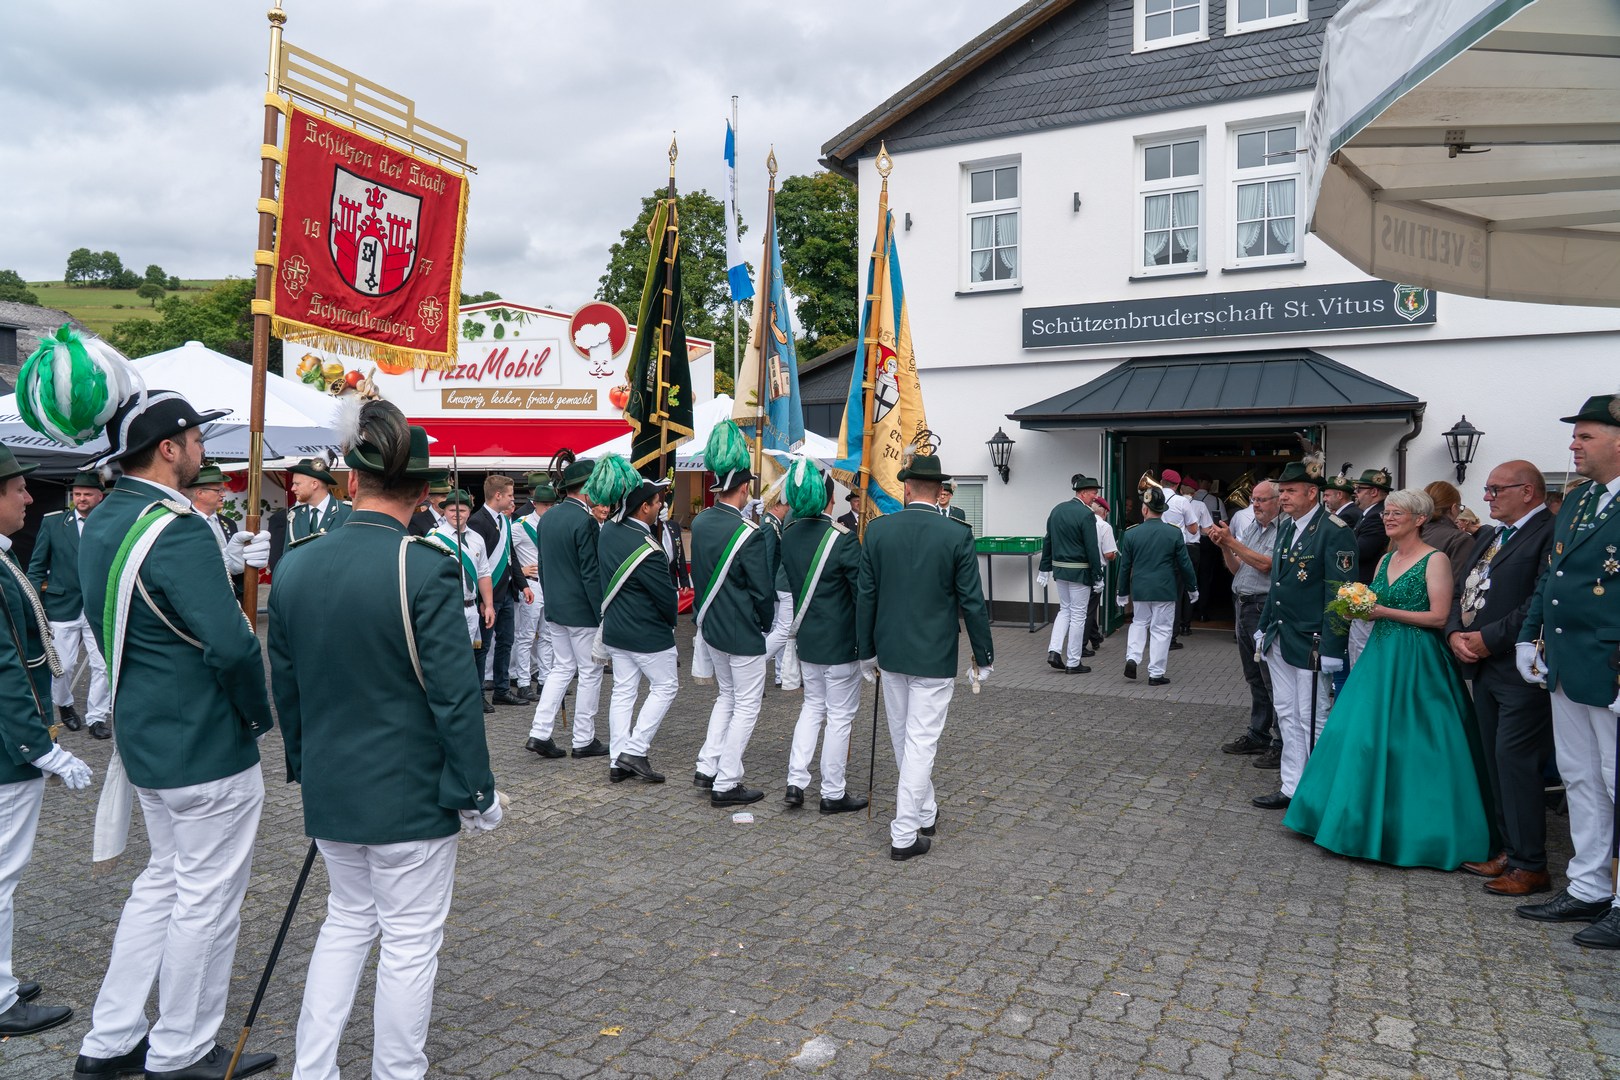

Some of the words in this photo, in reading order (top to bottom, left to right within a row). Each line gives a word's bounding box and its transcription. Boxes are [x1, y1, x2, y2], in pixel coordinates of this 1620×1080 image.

[304, 119, 372, 168] Schützen
[380, 155, 403, 179] der
[408, 163, 446, 195] Stadt
[419, 258, 434, 275] 77
[307, 292, 416, 342] Schmallenberg
[1032, 302, 1274, 335] Schützenbruderschaft
[447, 390, 486, 409] knusprig,
[491, 391, 523, 408] lecker,
[526, 392, 554, 409] frisch
[556, 392, 593, 409] gemacht
